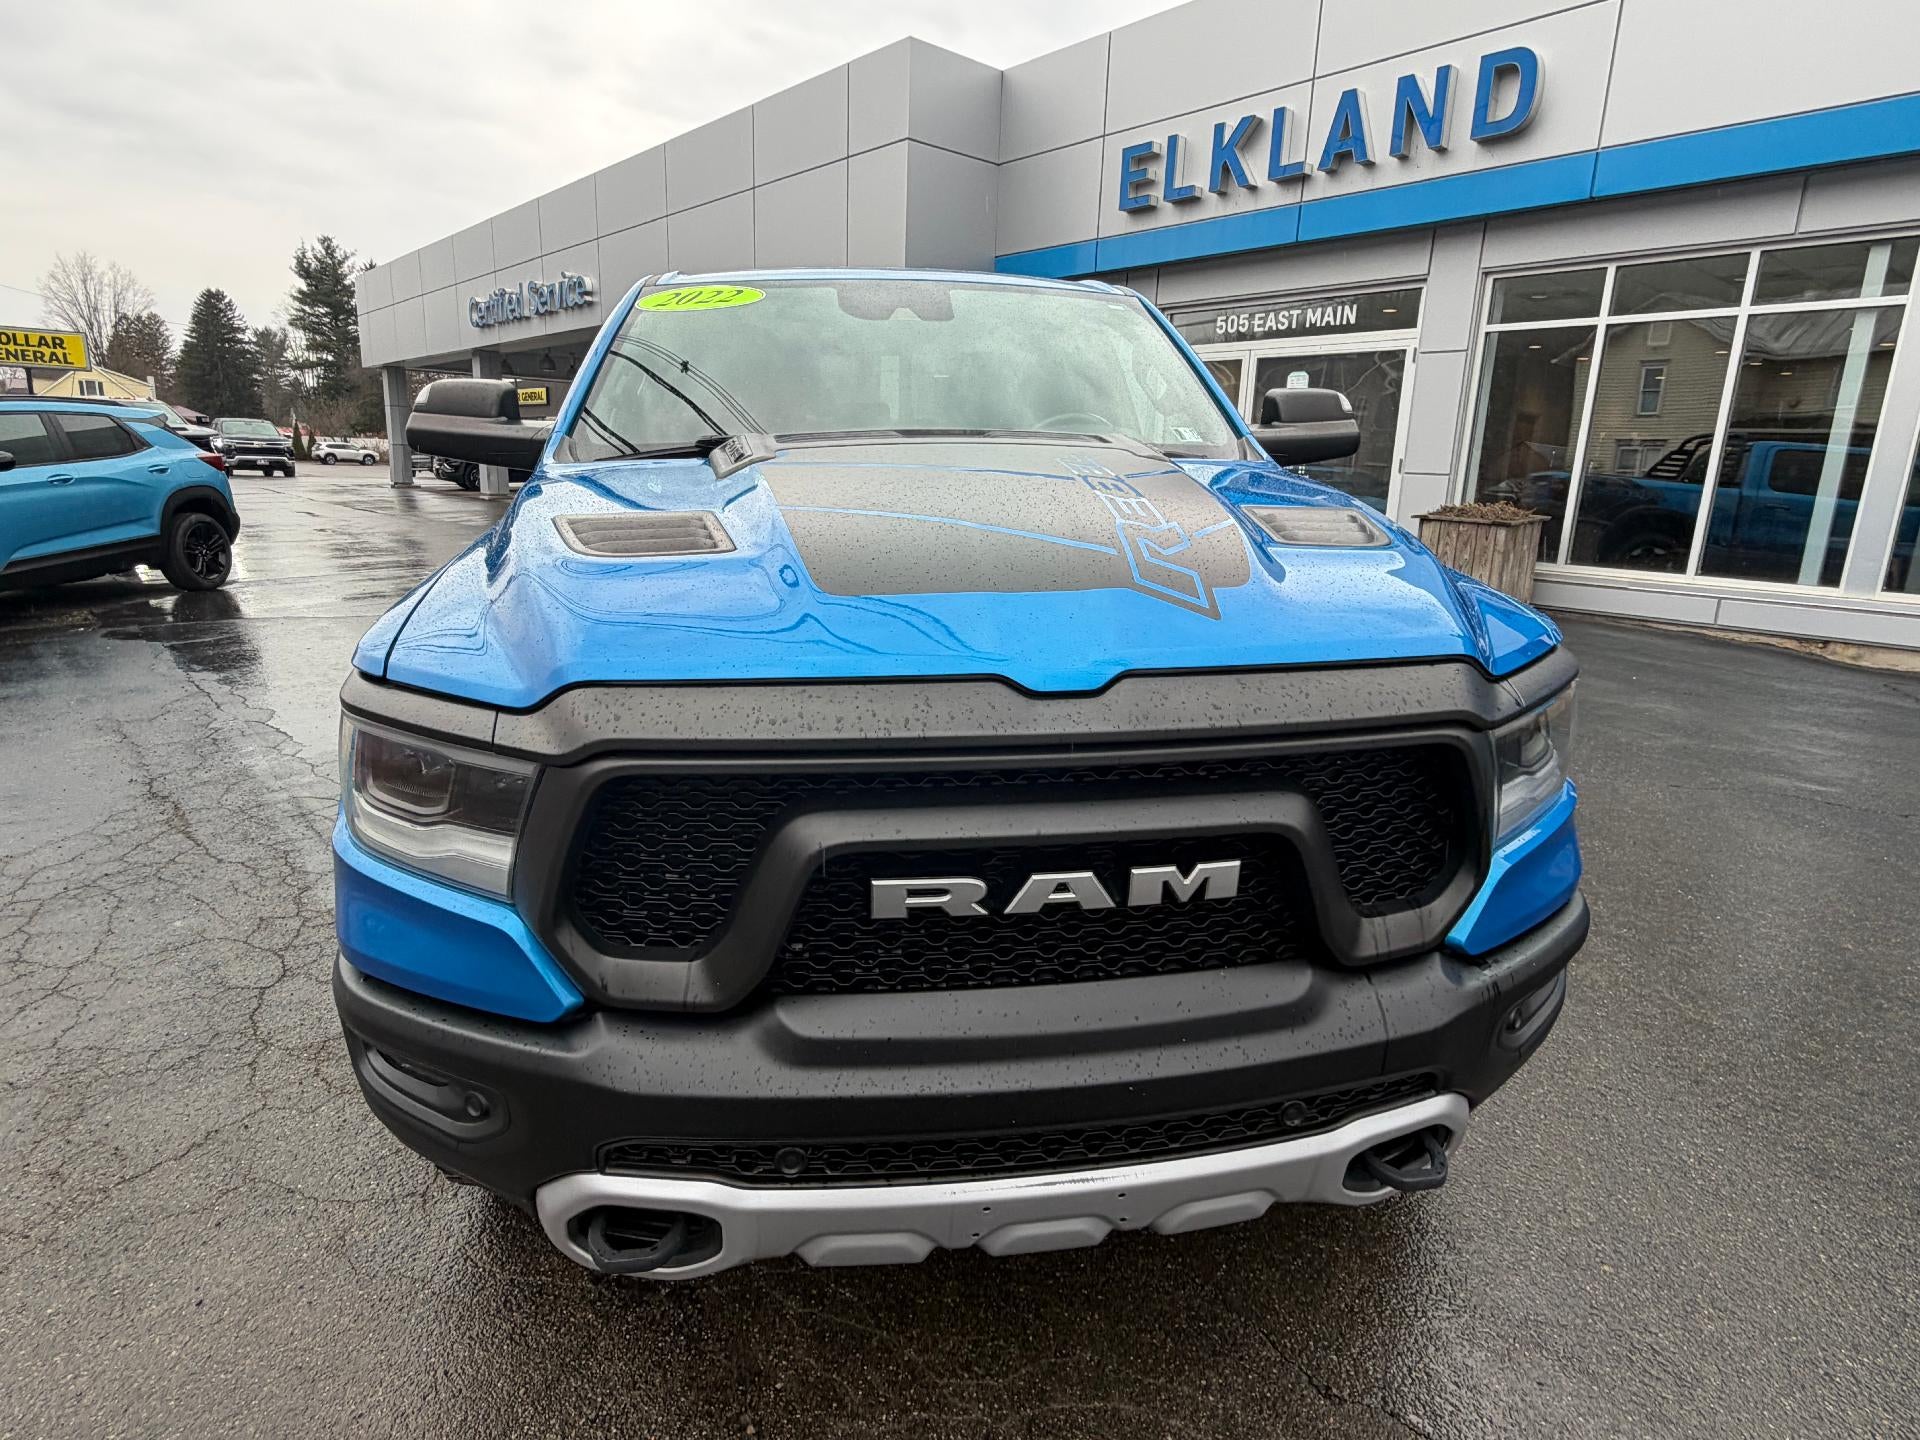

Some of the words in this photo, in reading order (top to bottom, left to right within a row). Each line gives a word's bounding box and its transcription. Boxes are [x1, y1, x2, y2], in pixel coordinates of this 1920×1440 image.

[1118, 46, 1543, 213] ELKLAND
[469, 282, 525, 328] Certified
[528, 271, 591, 316] Service
[652, 289, 744, 308] 2022
[1216, 316, 1249, 335] 505
[1253, 310, 1302, 333] EAST
[1305, 304, 1358, 327] MAIN
[0, 331, 66, 350] OLLAR
[870, 859, 1242, 919] RAM
